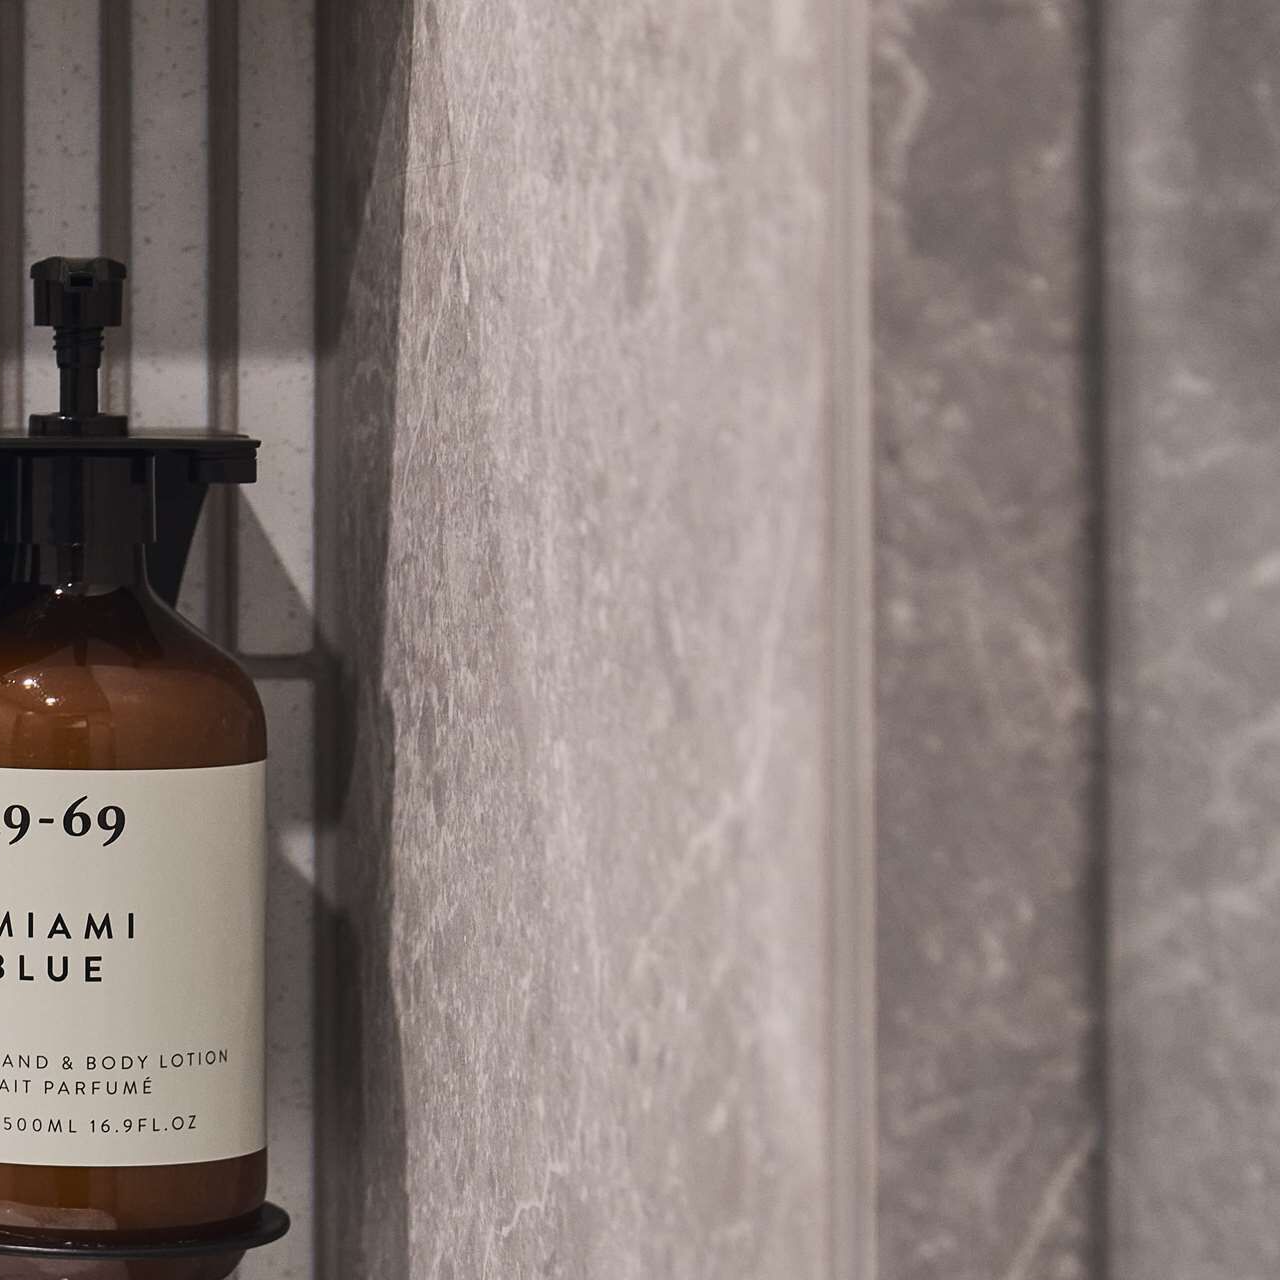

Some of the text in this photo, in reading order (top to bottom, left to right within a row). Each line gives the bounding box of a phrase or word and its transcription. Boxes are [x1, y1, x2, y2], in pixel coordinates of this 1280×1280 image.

[61, 1055, 73, 1071] &
[86, 1055, 148, 1071] BODY
[159, 1049, 228, 1069] LOTION
[44, 1076, 152, 1096] PARFUMÉ
